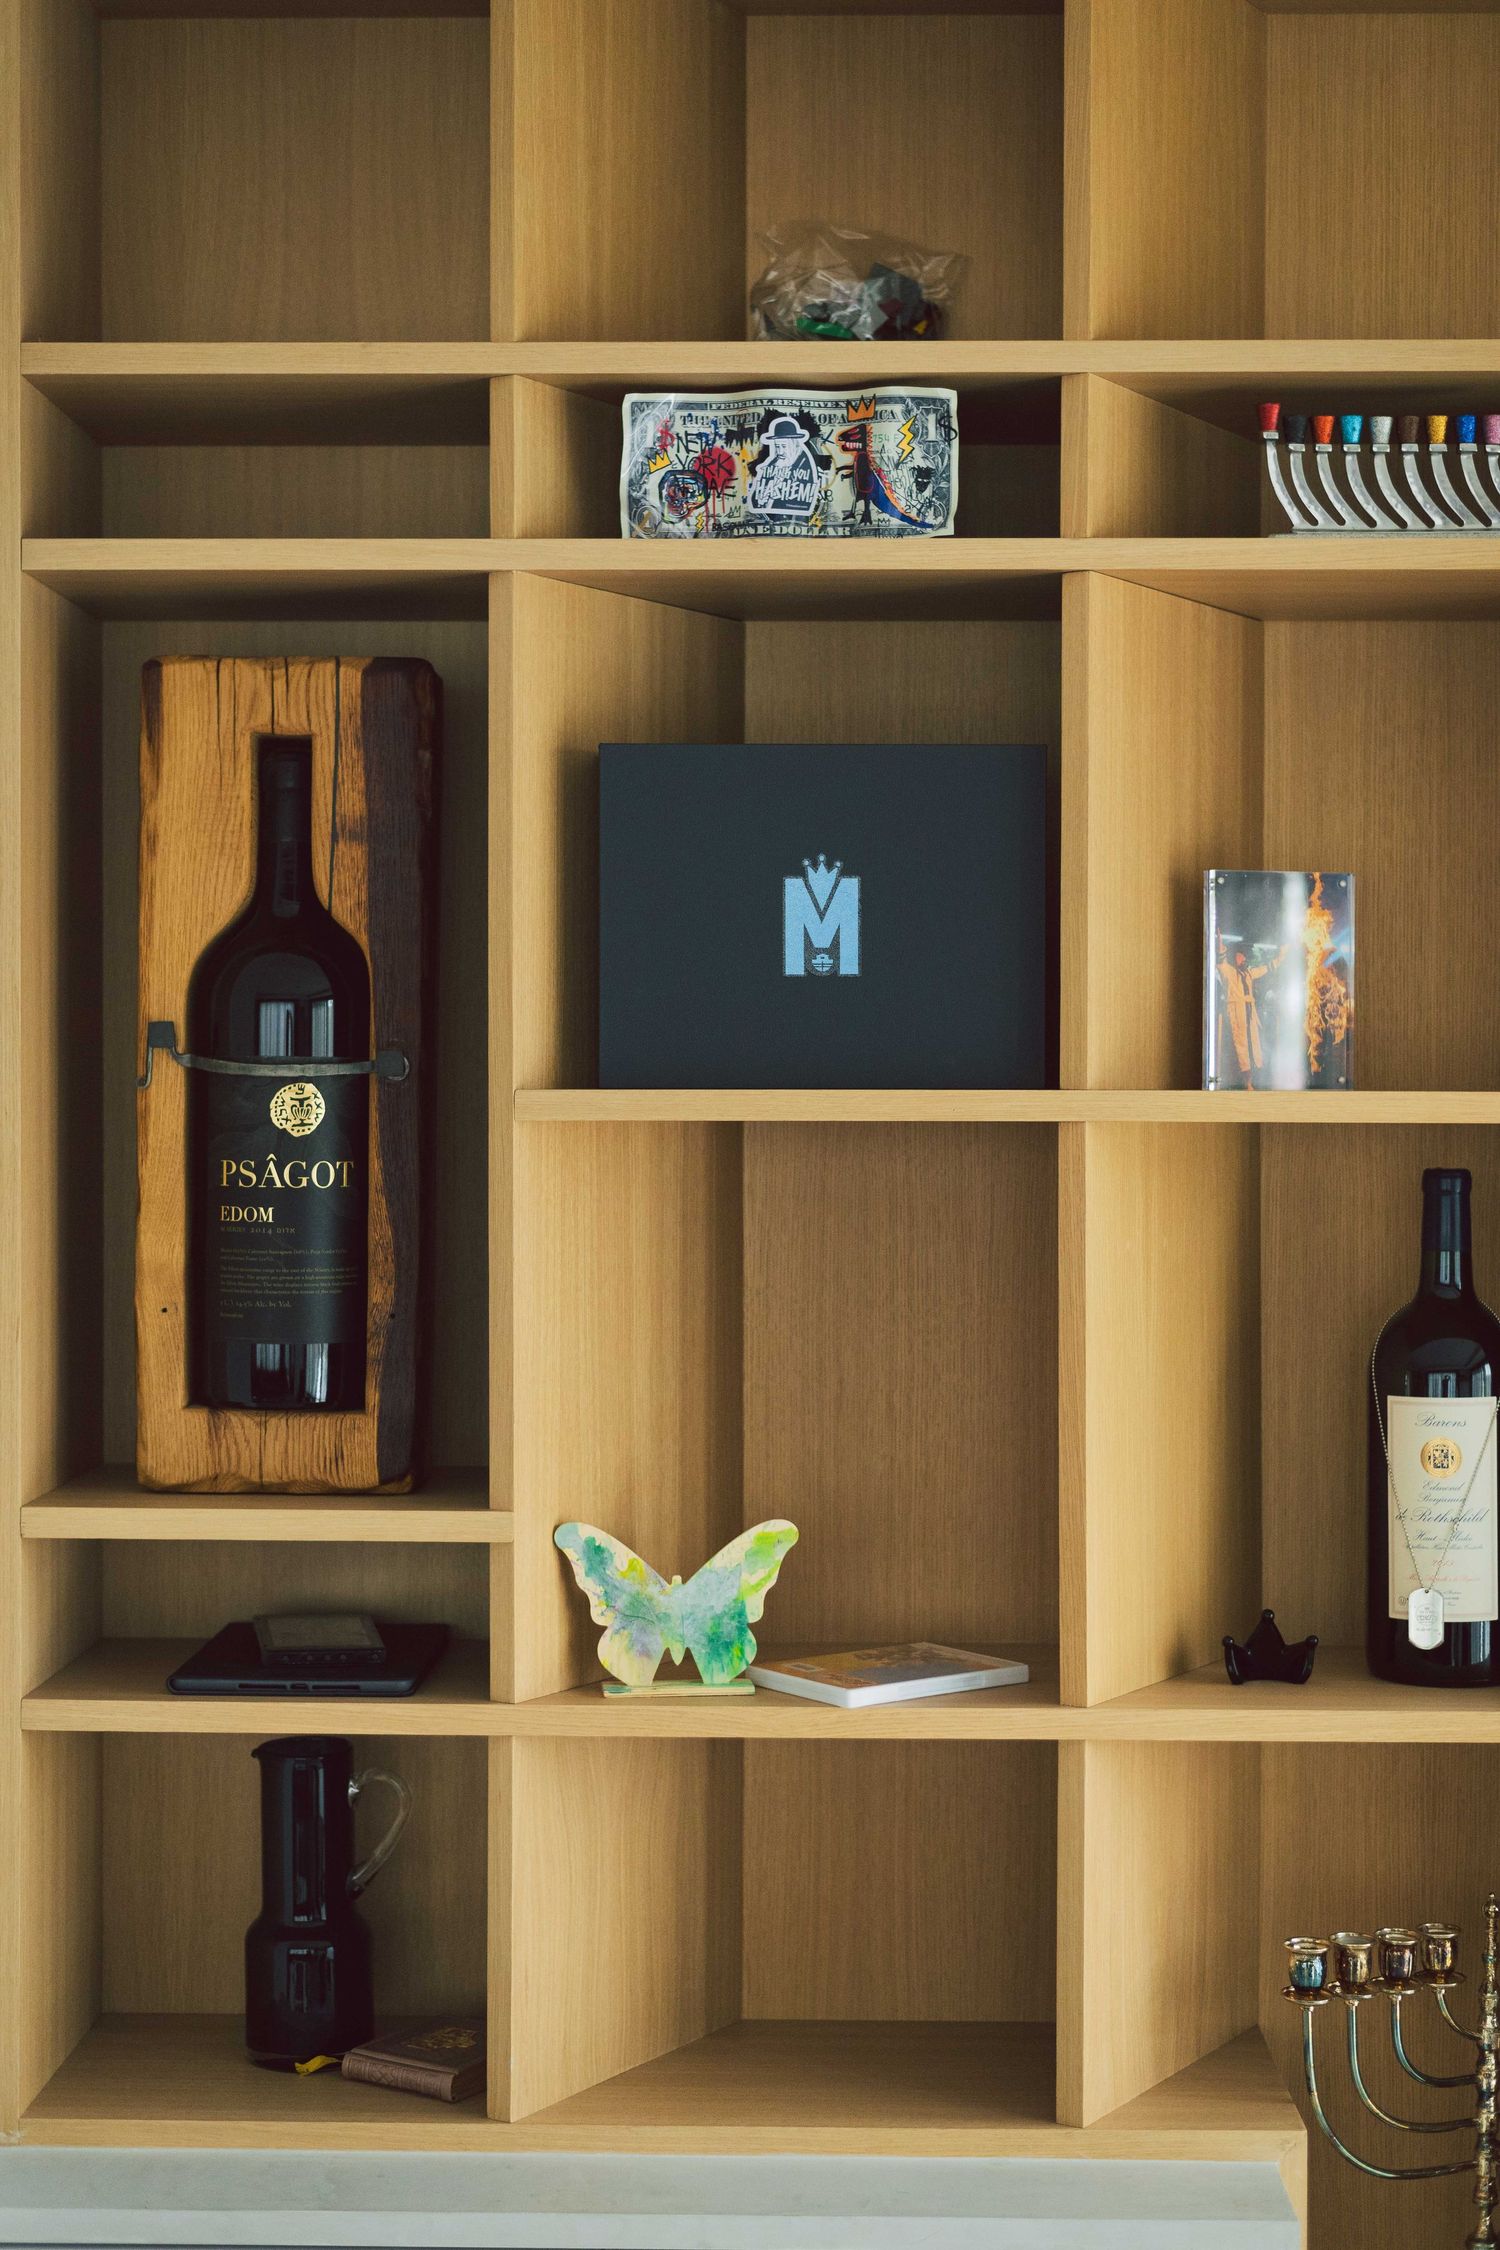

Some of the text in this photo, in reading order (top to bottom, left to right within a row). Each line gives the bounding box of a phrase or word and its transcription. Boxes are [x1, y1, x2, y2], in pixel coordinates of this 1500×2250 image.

[838, 408, 897, 424] AICA
[675, 453, 734, 478] YORK
[755, 478, 817, 503] HASHEM!
[774, 525, 851, 536] DOLLAR
[220, 1153, 355, 1190] PSÂGOT
[220, 1206, 275, 1223] EDOM
[1415, 1411, 1467, 1428] Barons
